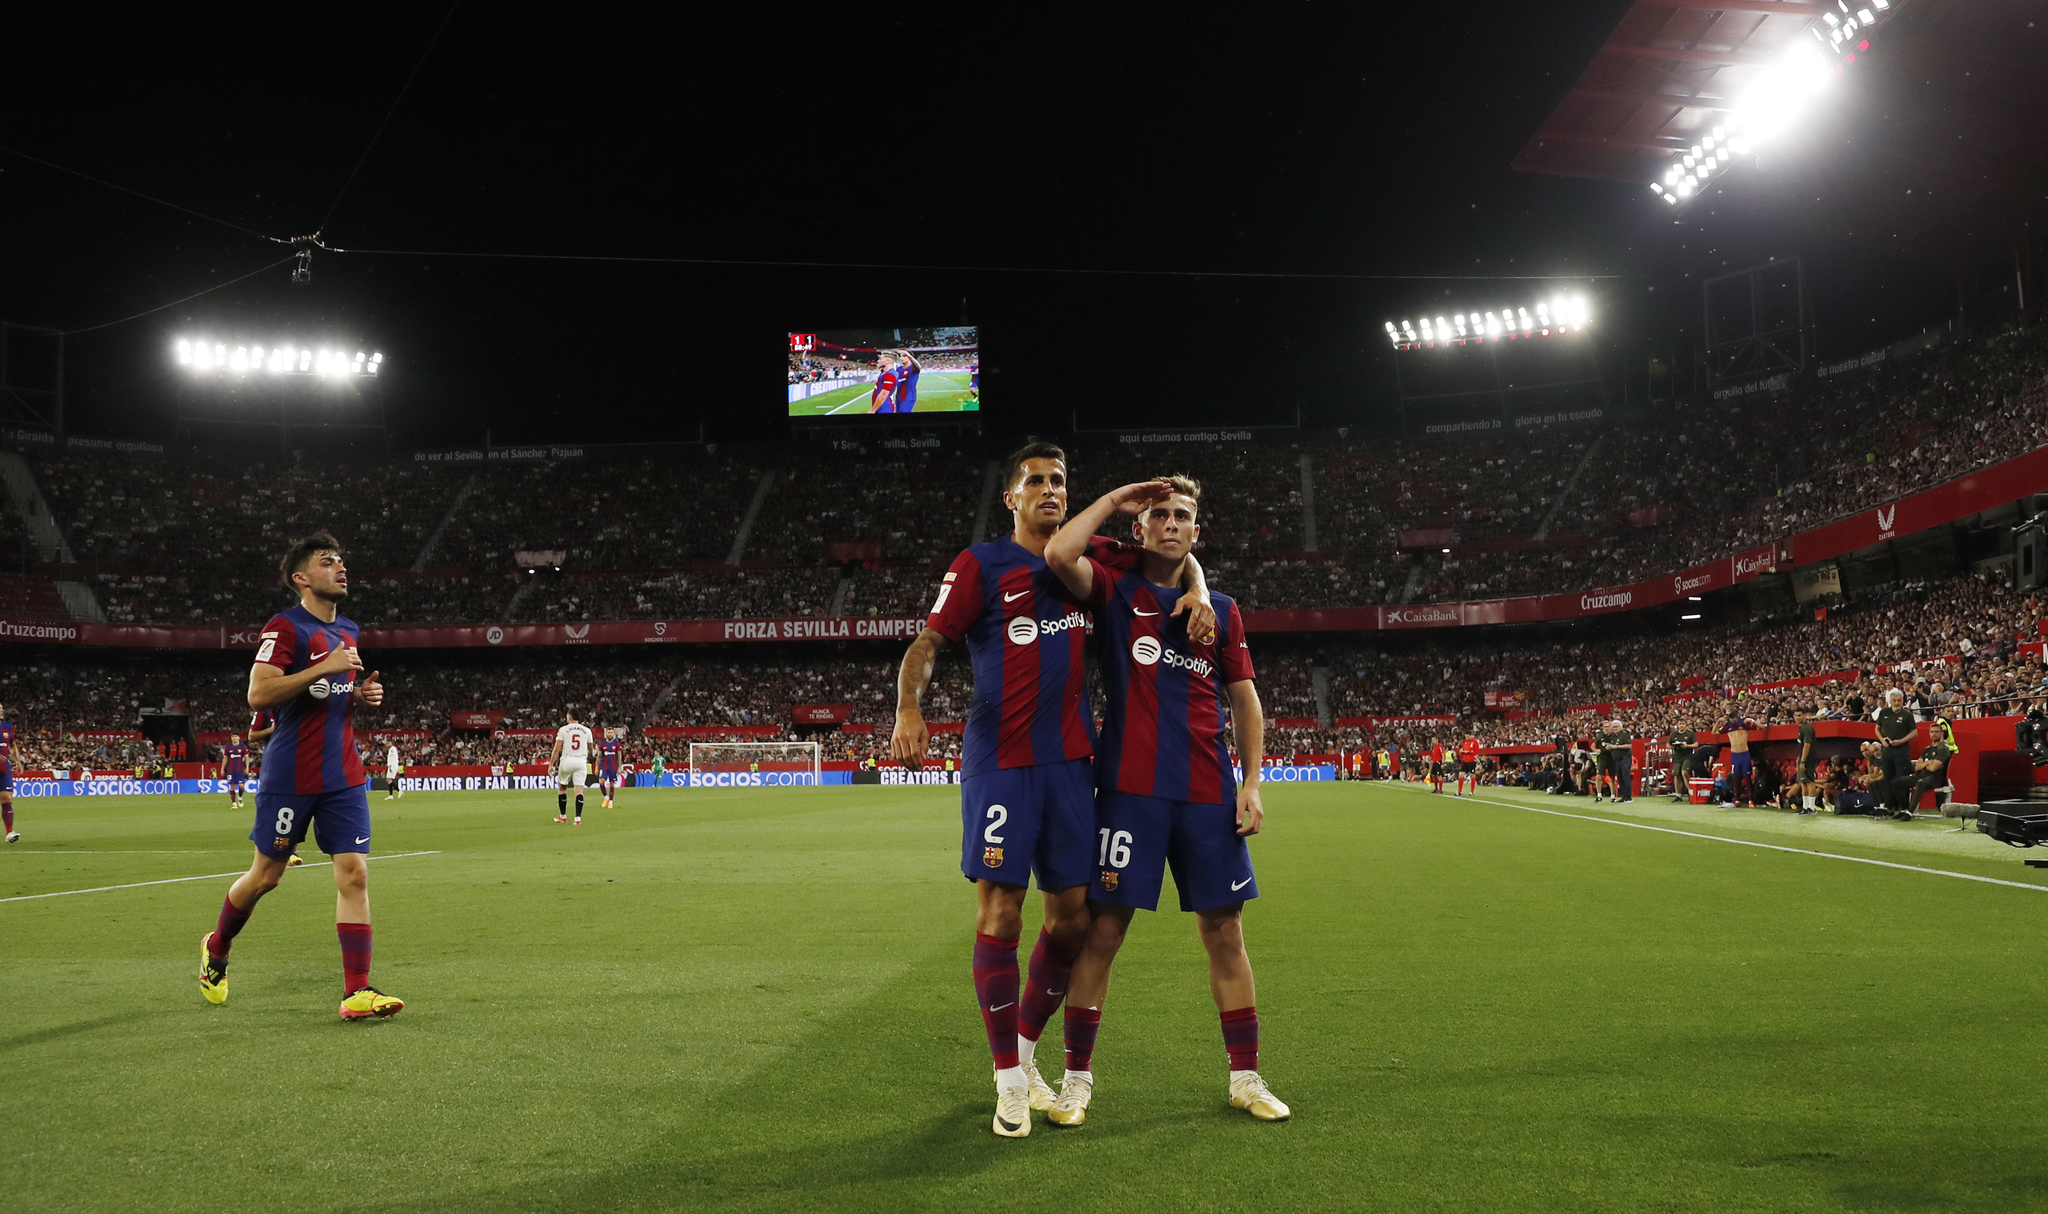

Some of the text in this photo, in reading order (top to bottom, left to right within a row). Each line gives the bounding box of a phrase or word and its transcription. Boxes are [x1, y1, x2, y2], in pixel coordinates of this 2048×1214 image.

[794, 335, 813, 345] 1 1
[1817, 349, 1886, 378] de nuestra ciudad
[1713, 383, 1743, 400] orgullo
[1744, 381, 1758, 393] del
[1425, 407, 1602, 434] compartiendo la gloria en tu escudo
[16, 429, 55, 444] Giralda
[67, 436, 113, 448] presume
[116, 440, 164, 453] orgullosa
[832, 440, 839, 450] Y
[910, 438, 941, 448] Sevilla
[1119, 430, 1252, 444] aquí estamos contigo Sevilla
[414, 447, 583, 462] de ver al Sevilla en el Sánchez Pizjuán
[1581, 591, 1632, 611] Cruzcampo
[1040, 612, 1086, 635] Spotify
[1403, 609, 1458, 623] CaixaBank
[0, 620, 77, 641] Cruzcampo
[724, 621, 778, 639] FORZA
[783, 620, 850, 637] SEVILLA
[1162, 648, 1214, 679] Spotify
[571, 734, 581, 750] 5
[397, 775, 559, 791] CREATORS OF FAN TOKENS
[692, 771, 814, 787] SOCIOS.com
[880, 771, 949, 785] CREATORS
[88, 780, 180, 796] SOCIOS.com
[275, 807, 295, 835] 8
[984, 804, 1008, 844] 2
[1098, 827, 1133, 869] 16
